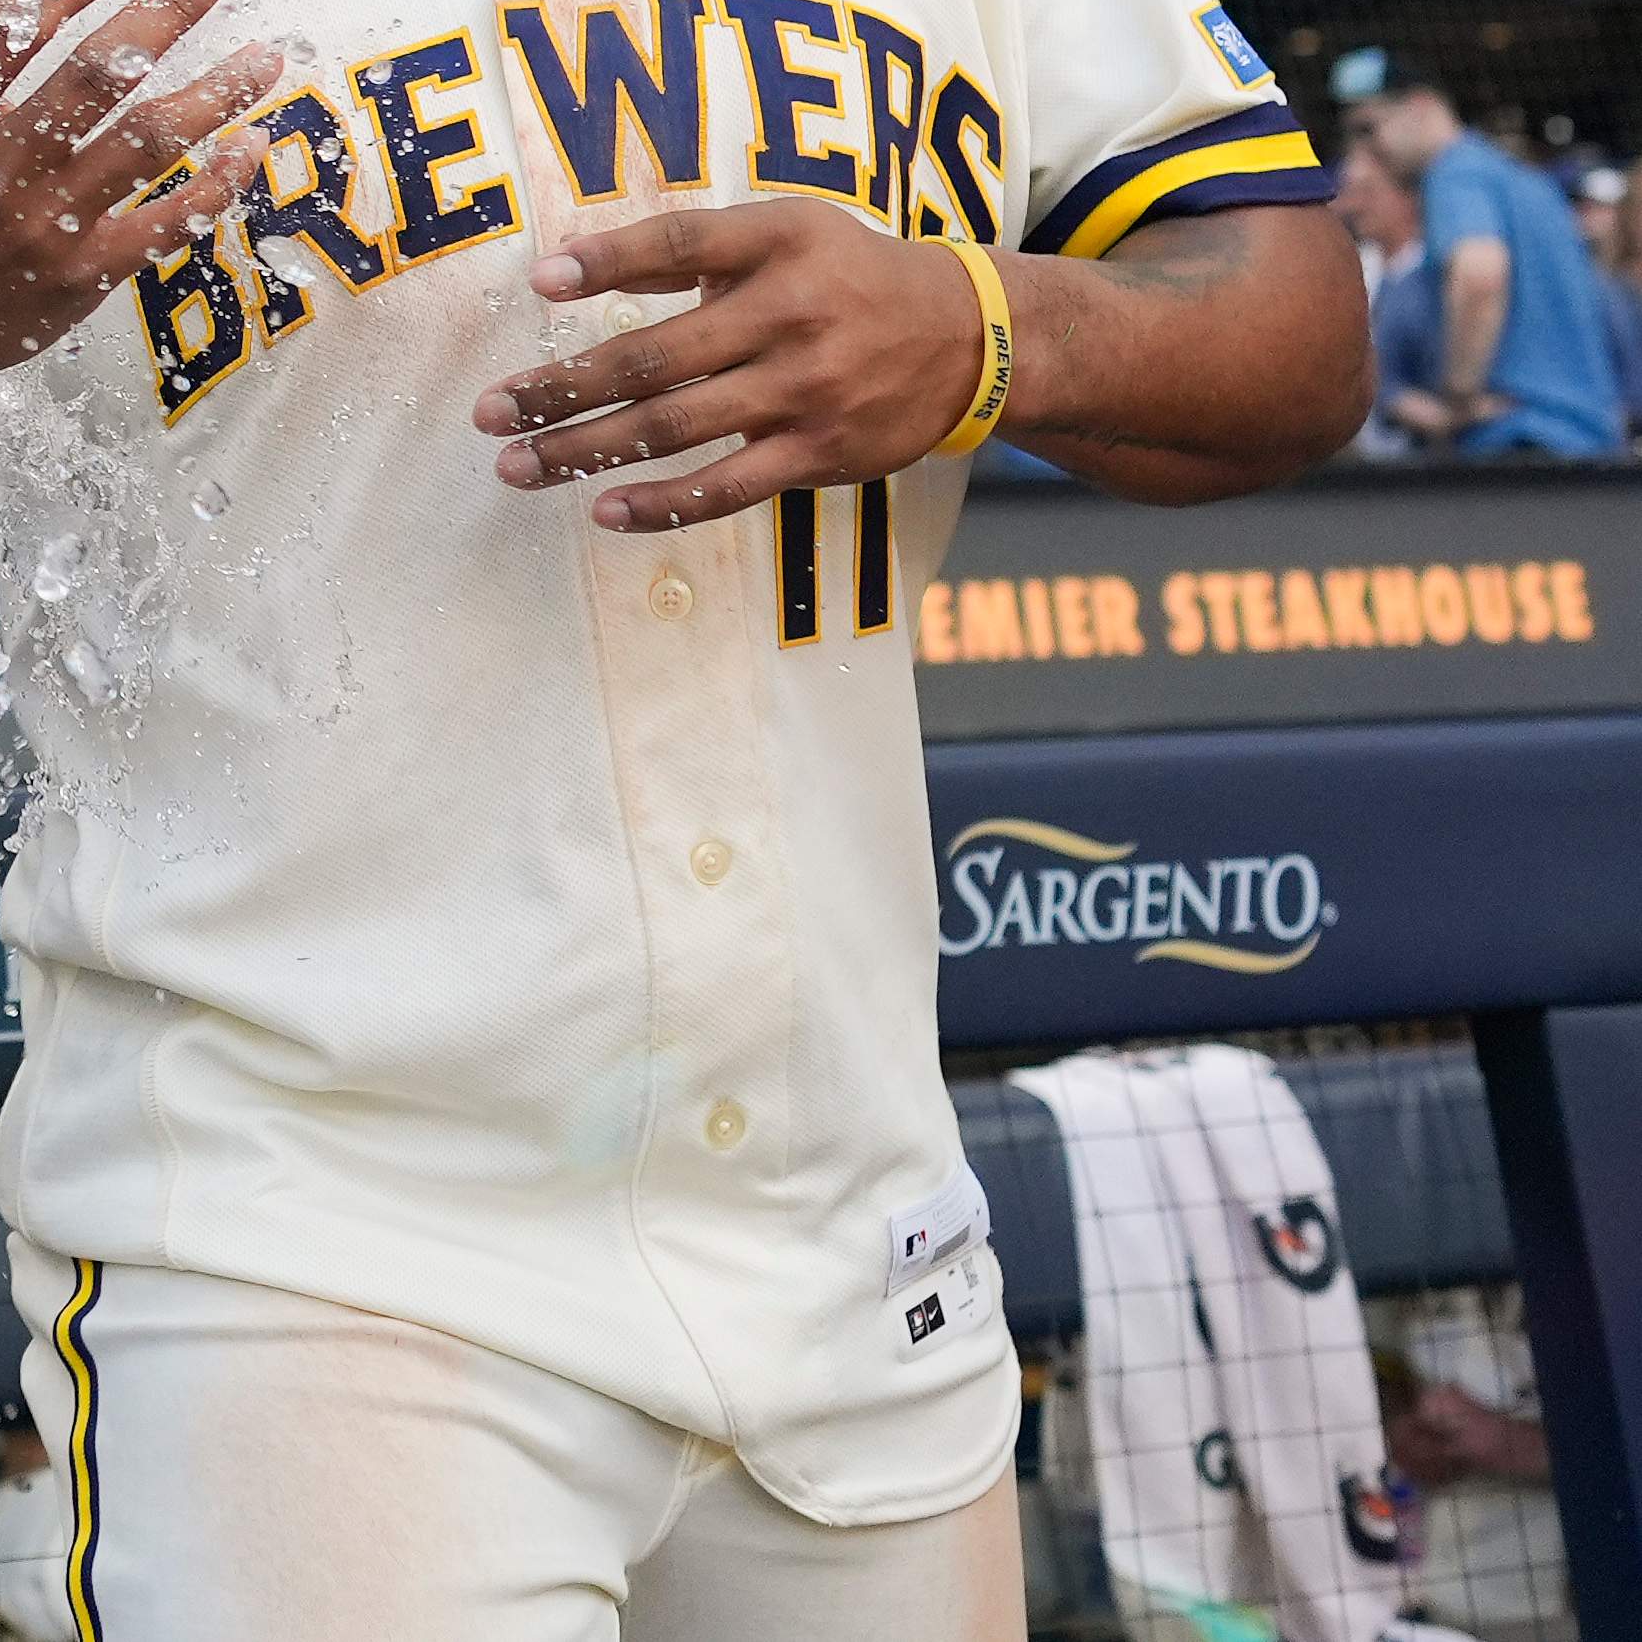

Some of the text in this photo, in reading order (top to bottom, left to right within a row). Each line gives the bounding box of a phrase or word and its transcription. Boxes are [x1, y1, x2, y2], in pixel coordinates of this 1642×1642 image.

[973, 321, 1011, 422] BREWERS
[1161, 560, 1596, 657] STEAKHOUSE
[938, 846, 1319, 957] SARGENTO
